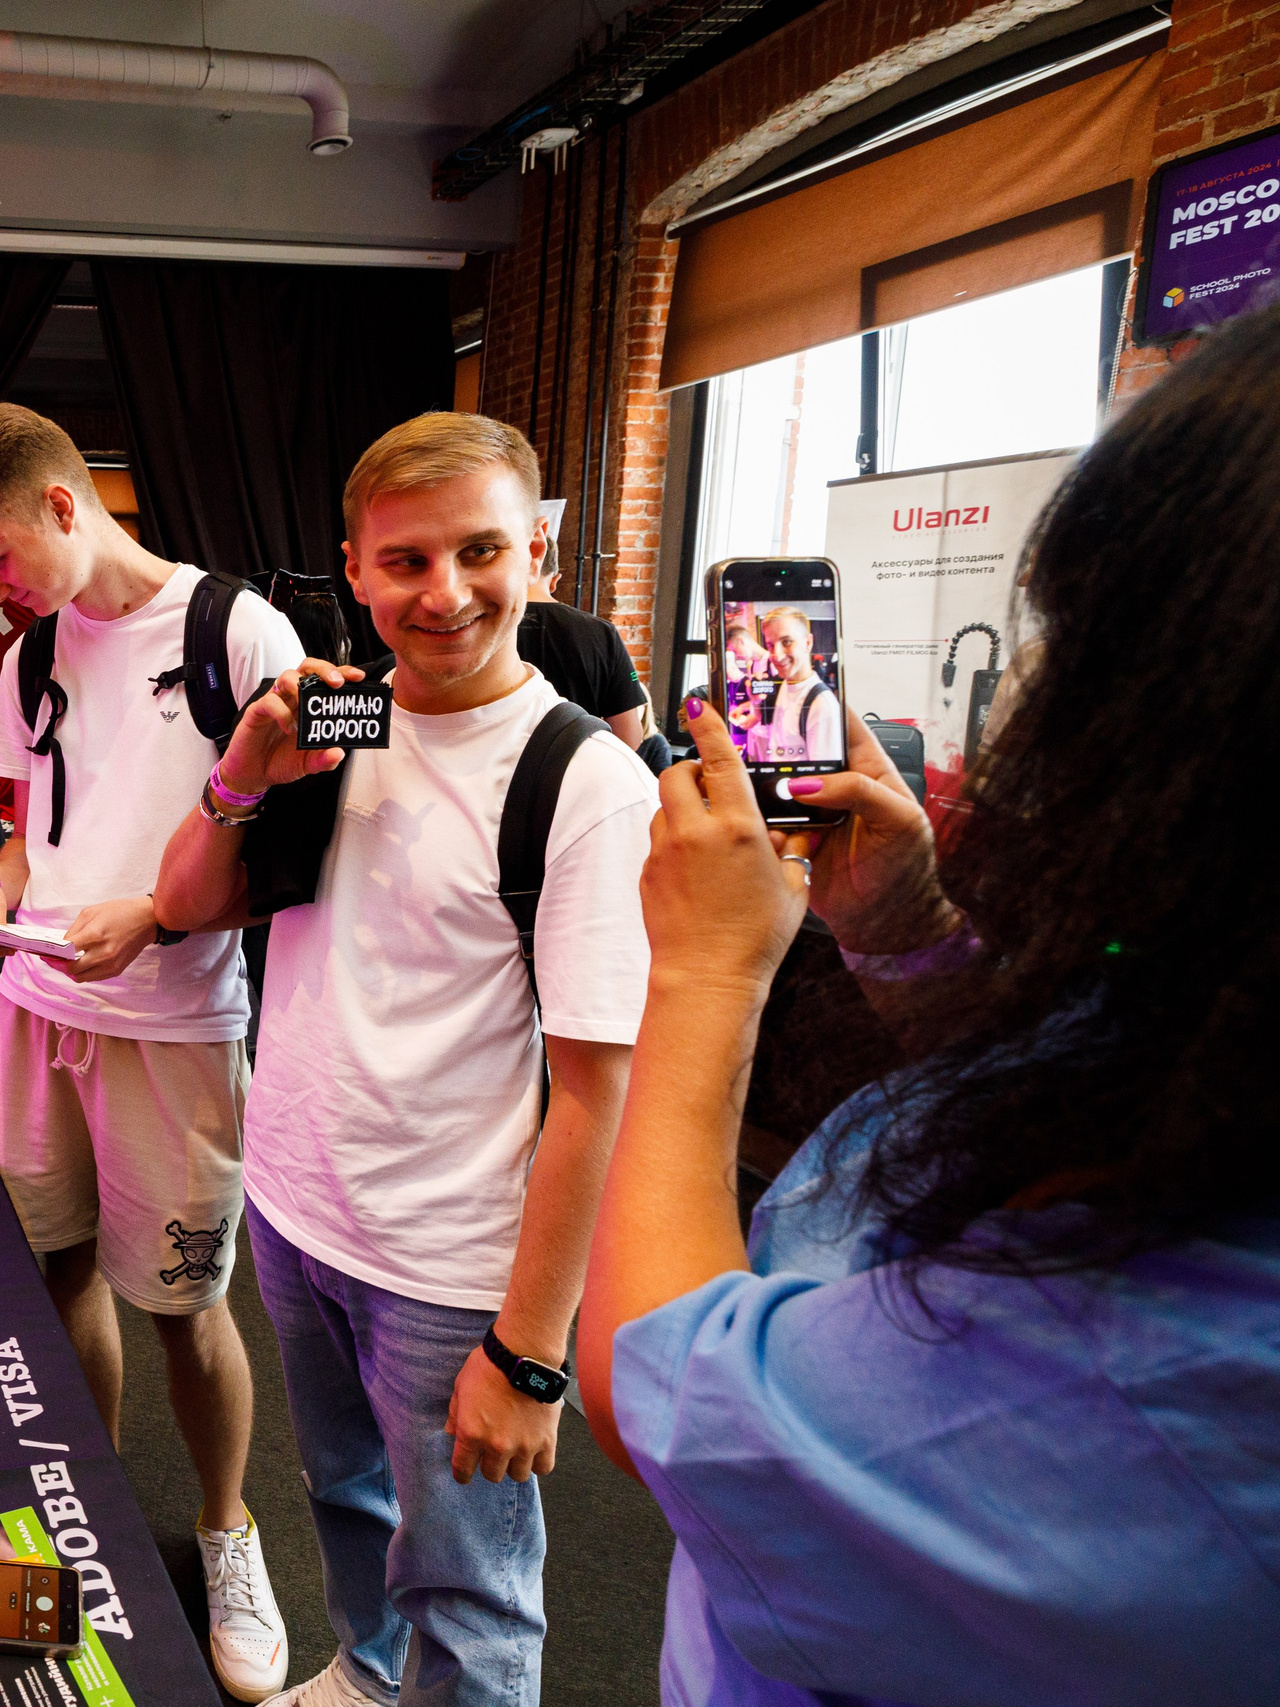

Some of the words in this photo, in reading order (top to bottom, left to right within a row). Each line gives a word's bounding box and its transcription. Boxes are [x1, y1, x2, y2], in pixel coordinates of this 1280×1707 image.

[1200, 170, 1245, 191] АВГУСТА
[1247, 163, 1272, 176] 2024
[1169, 215, 1239, 250] FEST
[1189, 276, 1231, 293] SCHOOL
[1233, 268, 1271, 283] PHOTO
[1189, 288, 1216, 300] FEST
[1216, 282, 1240, 295] 2024
[892, 505, 990, 532] Ulanzi
[871, 558, 934, 568] Аксессуары
[935, 557, 951, 565] для
[953, 553, 1005, 563] создания
[876, 571, 907, 580] фото-
[918, 569, 946, 577] видео
[948, 566, 995, 575] контента
[307, 694, 383, 716] СНИМАЮ
[307, 719, 380, 742] ДОРОГО
[19, 1438, 70, 1452] /
[31, 1461, 134, 1640] ADOBE
[77, 1663, 93, 1692] Каталог
